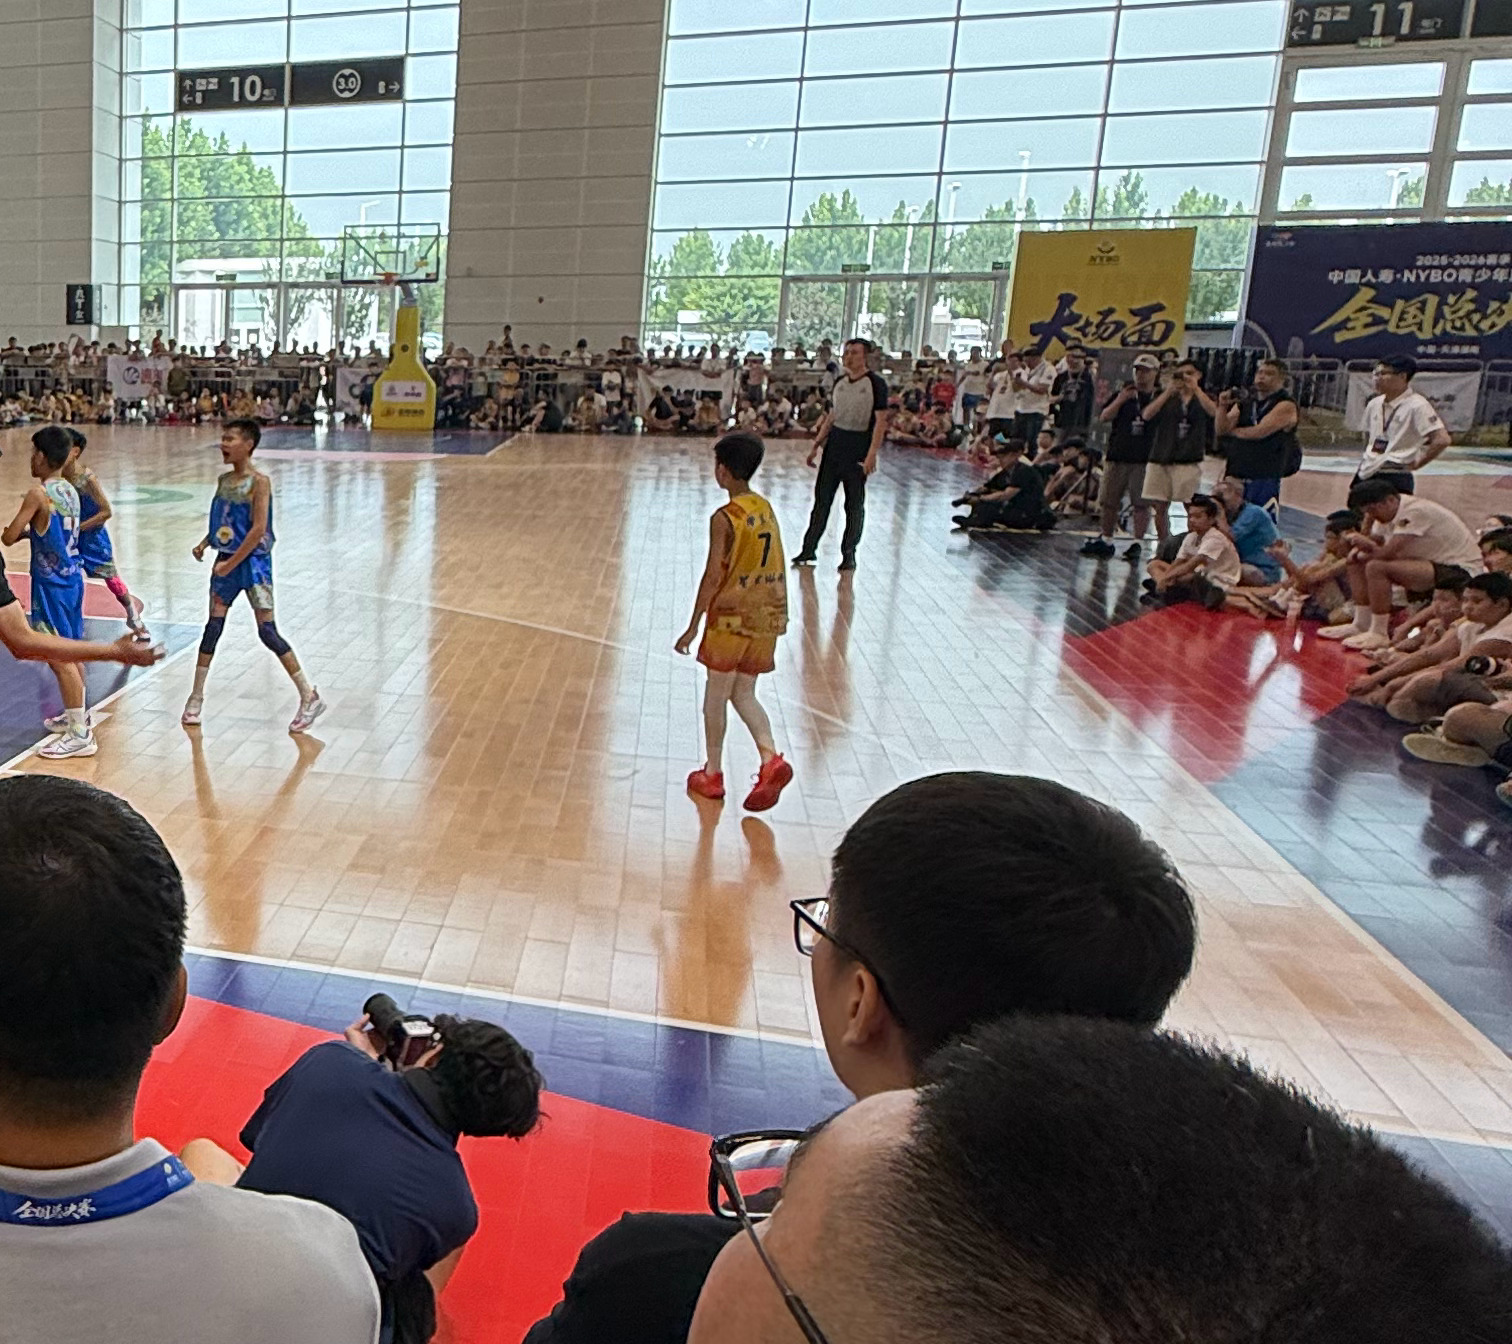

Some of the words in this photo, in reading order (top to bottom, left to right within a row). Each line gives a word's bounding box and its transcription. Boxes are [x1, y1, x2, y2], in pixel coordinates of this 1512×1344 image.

[1369, 1, 1414, 36] 11
[229, 74, 263, 102] 10
[337, 76, 356, 90] 3.0
[758, 532, 772, 568] 7
